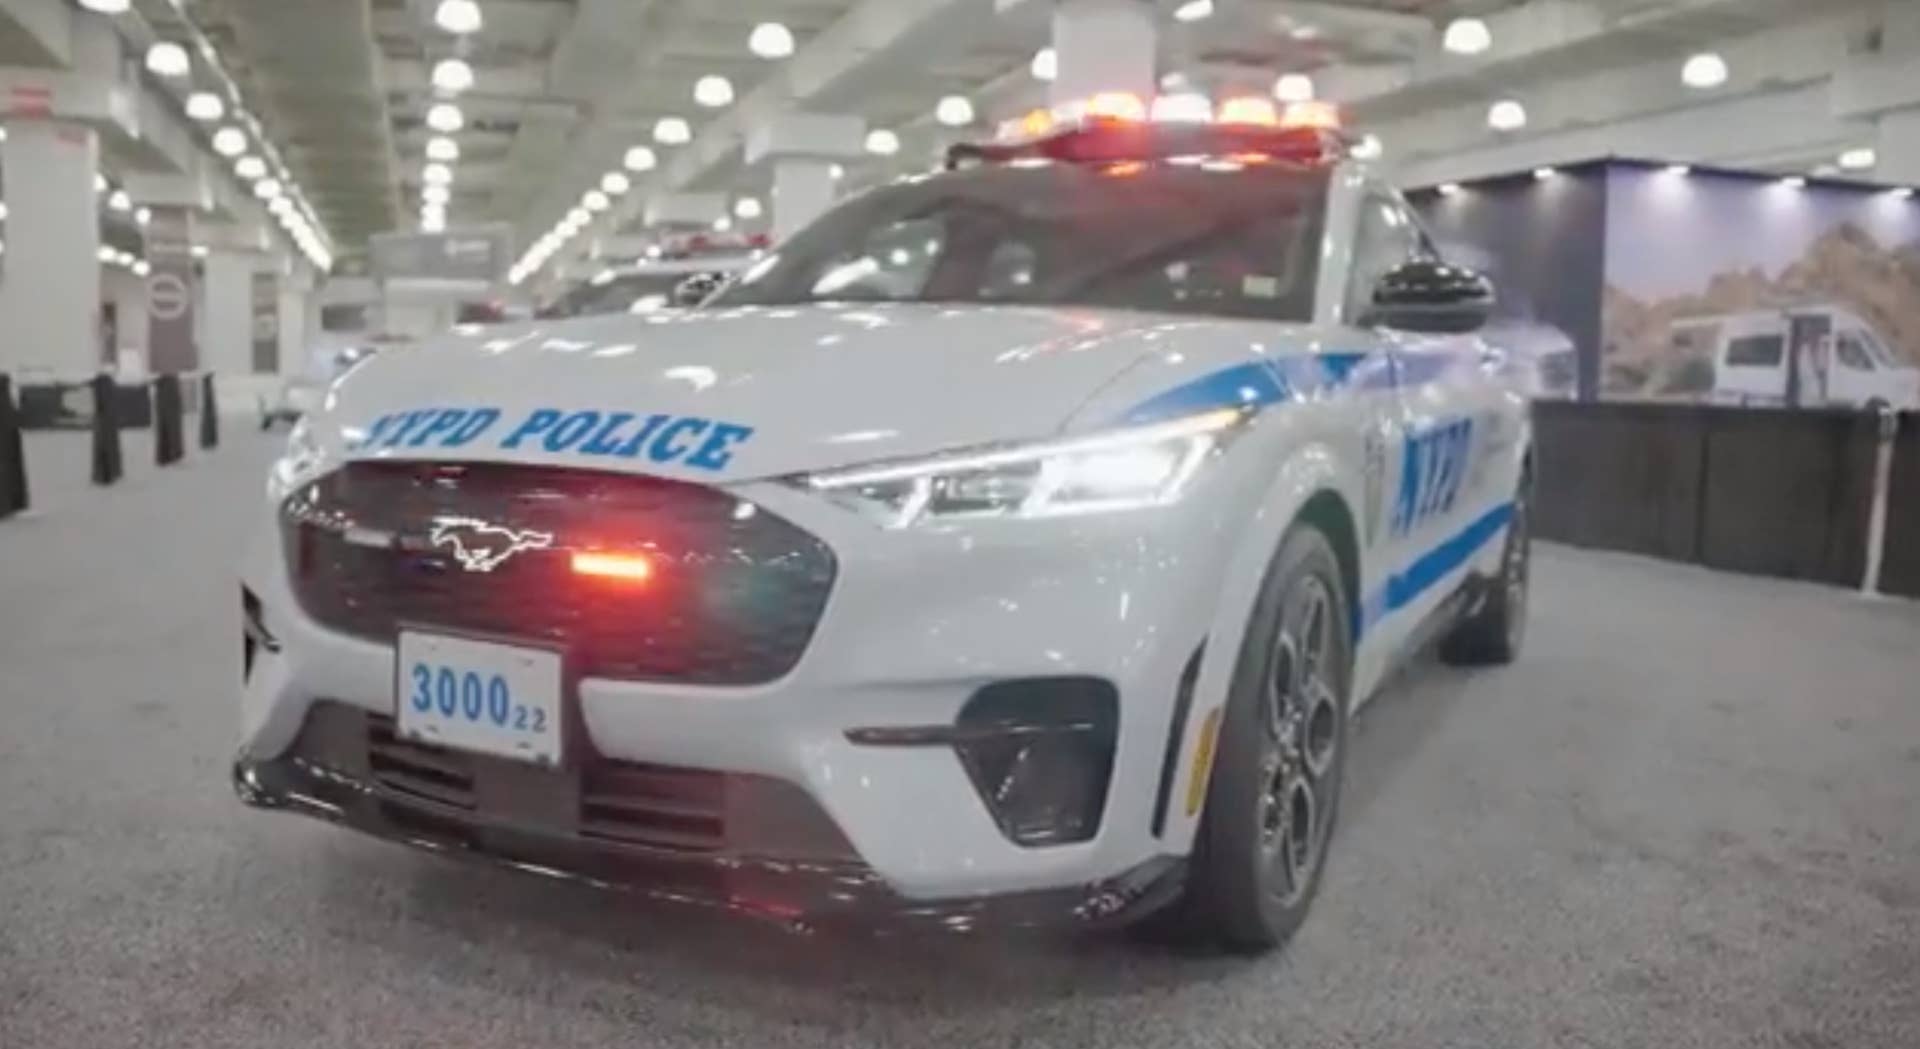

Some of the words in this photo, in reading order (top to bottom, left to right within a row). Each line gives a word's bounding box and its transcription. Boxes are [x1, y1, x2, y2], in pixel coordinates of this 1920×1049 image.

[500, 408, 754, 471] POLICE
[412, 663, 509, 725] 3000
[514, 705, 547, 732] 22
